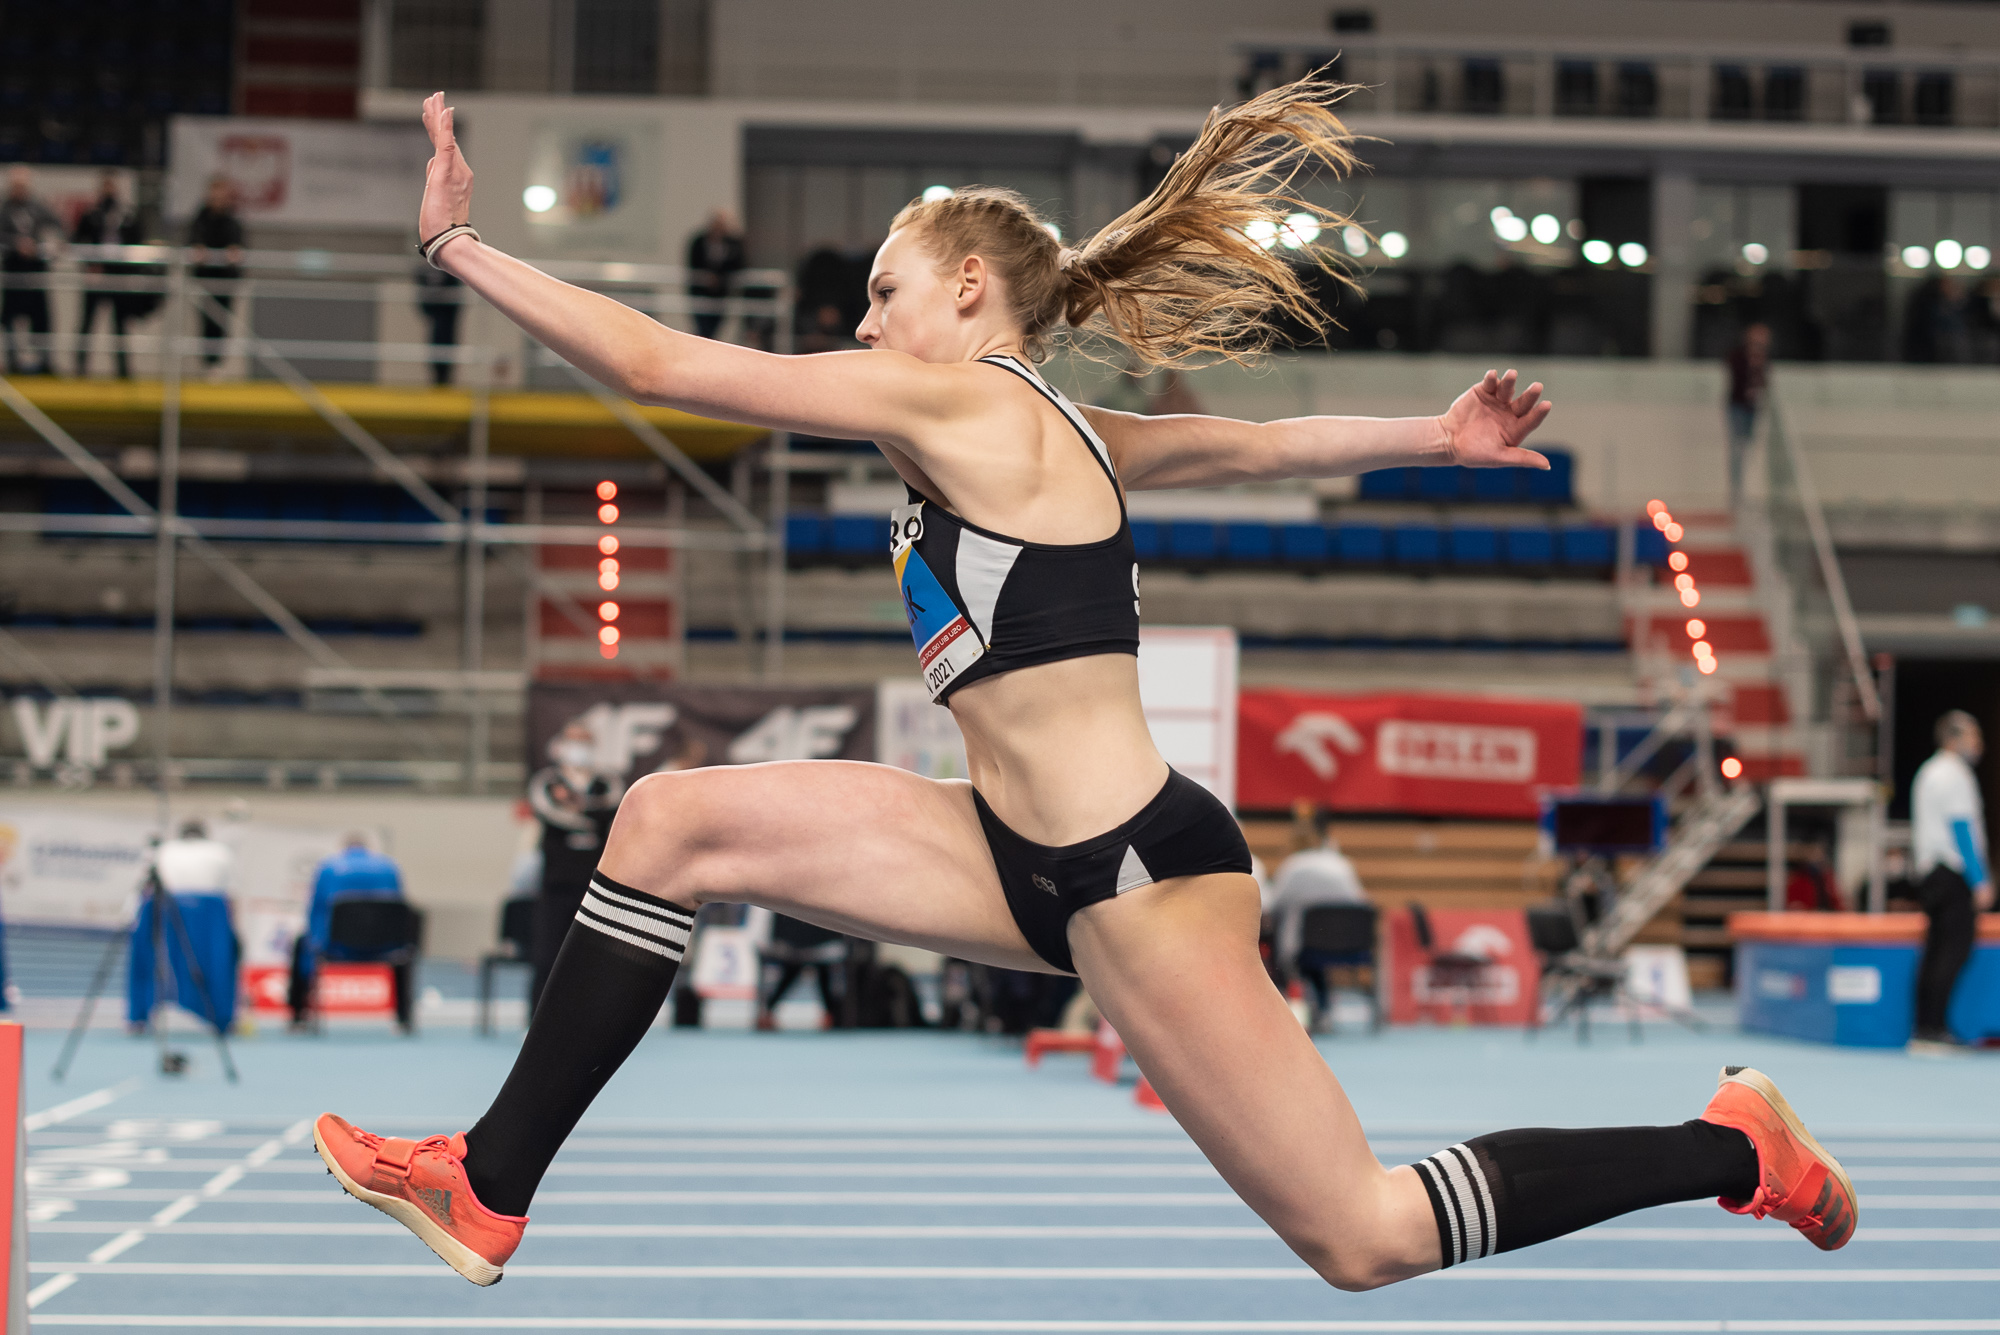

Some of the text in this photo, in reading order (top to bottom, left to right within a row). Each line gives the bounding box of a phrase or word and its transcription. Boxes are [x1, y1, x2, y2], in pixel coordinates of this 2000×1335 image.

[925, 643, 940, 660] POLSKI
[938, 634, 949, 646] U18
[948, 624, 962, 637] U20
[929, 657, 955, 690] 2021
[14, 695, 140, 767] VIP
[728, 705, 859, 763] 4F
[1031, 873, 1059, 897] esa
[416, 1188, 452, 1225] adidas
